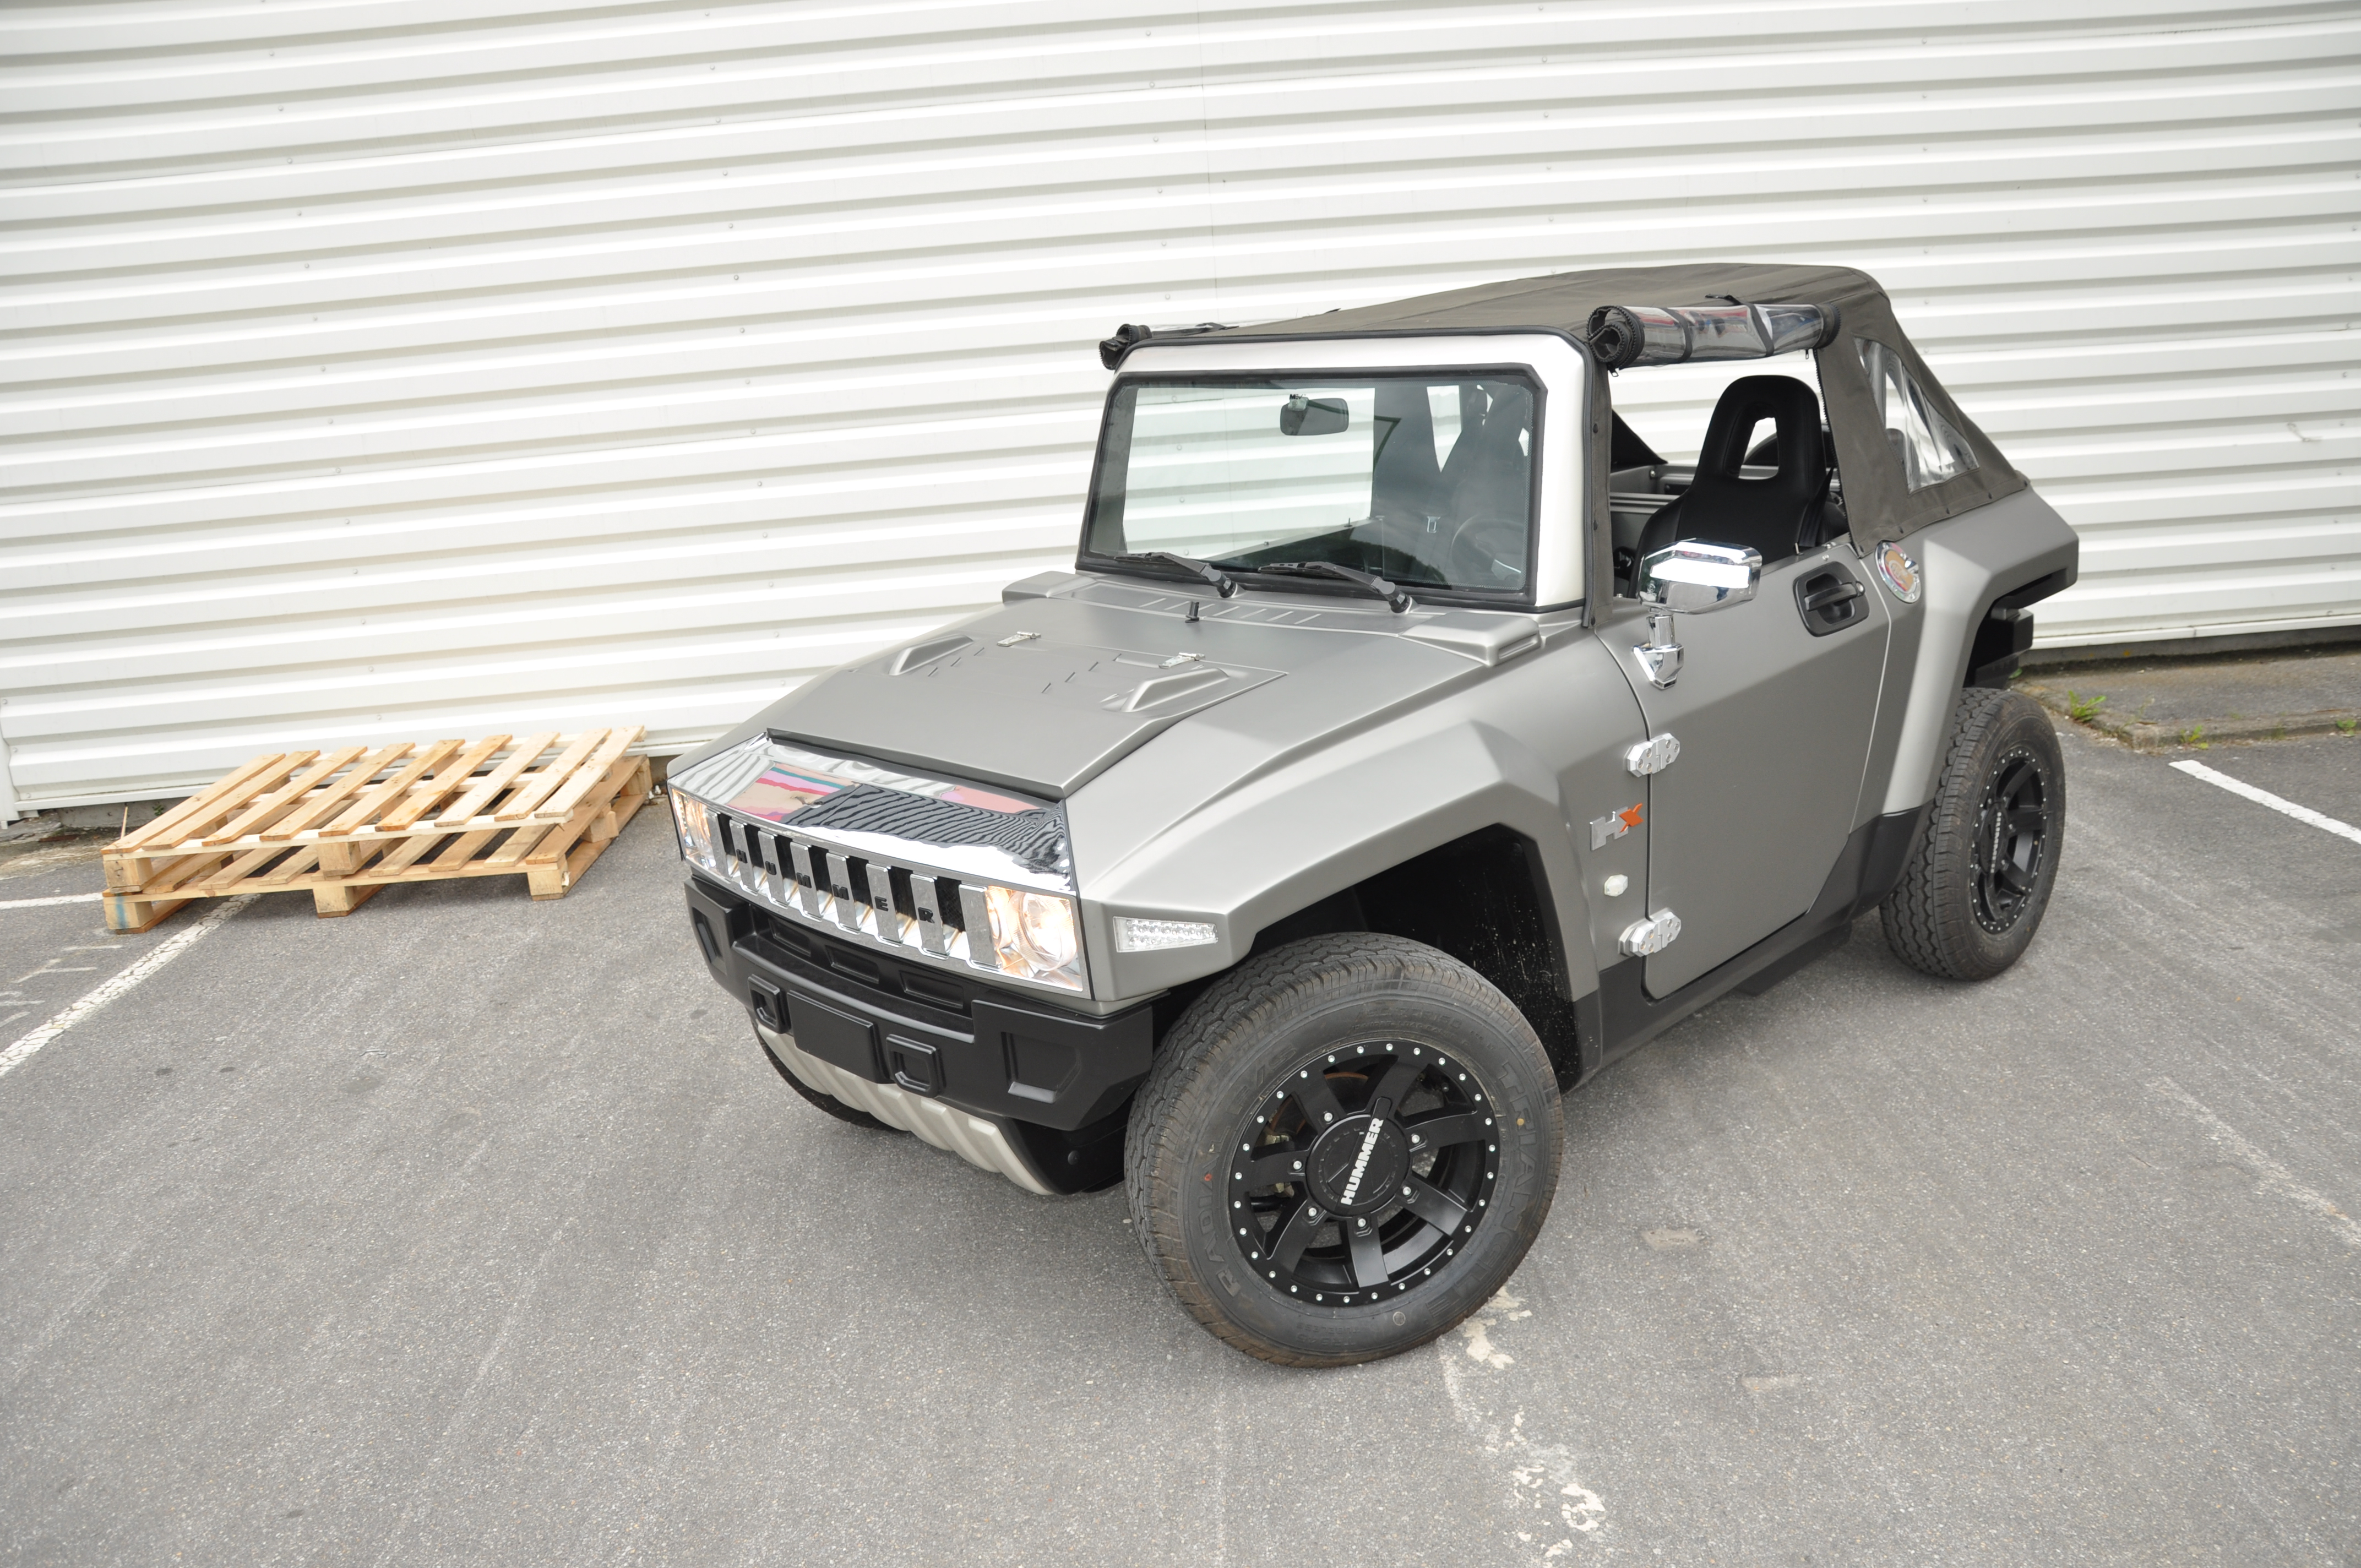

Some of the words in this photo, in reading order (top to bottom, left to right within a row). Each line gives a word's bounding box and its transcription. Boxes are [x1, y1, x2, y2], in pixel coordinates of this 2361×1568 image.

[736, 848, 935, 924] HUMMER
[1196, 1121, 1247, 1298] RADIAL
[1340, 1118, 1384, 1205] HUMMER
[1423, 1058, 1538, 1319] TRIANGLE
